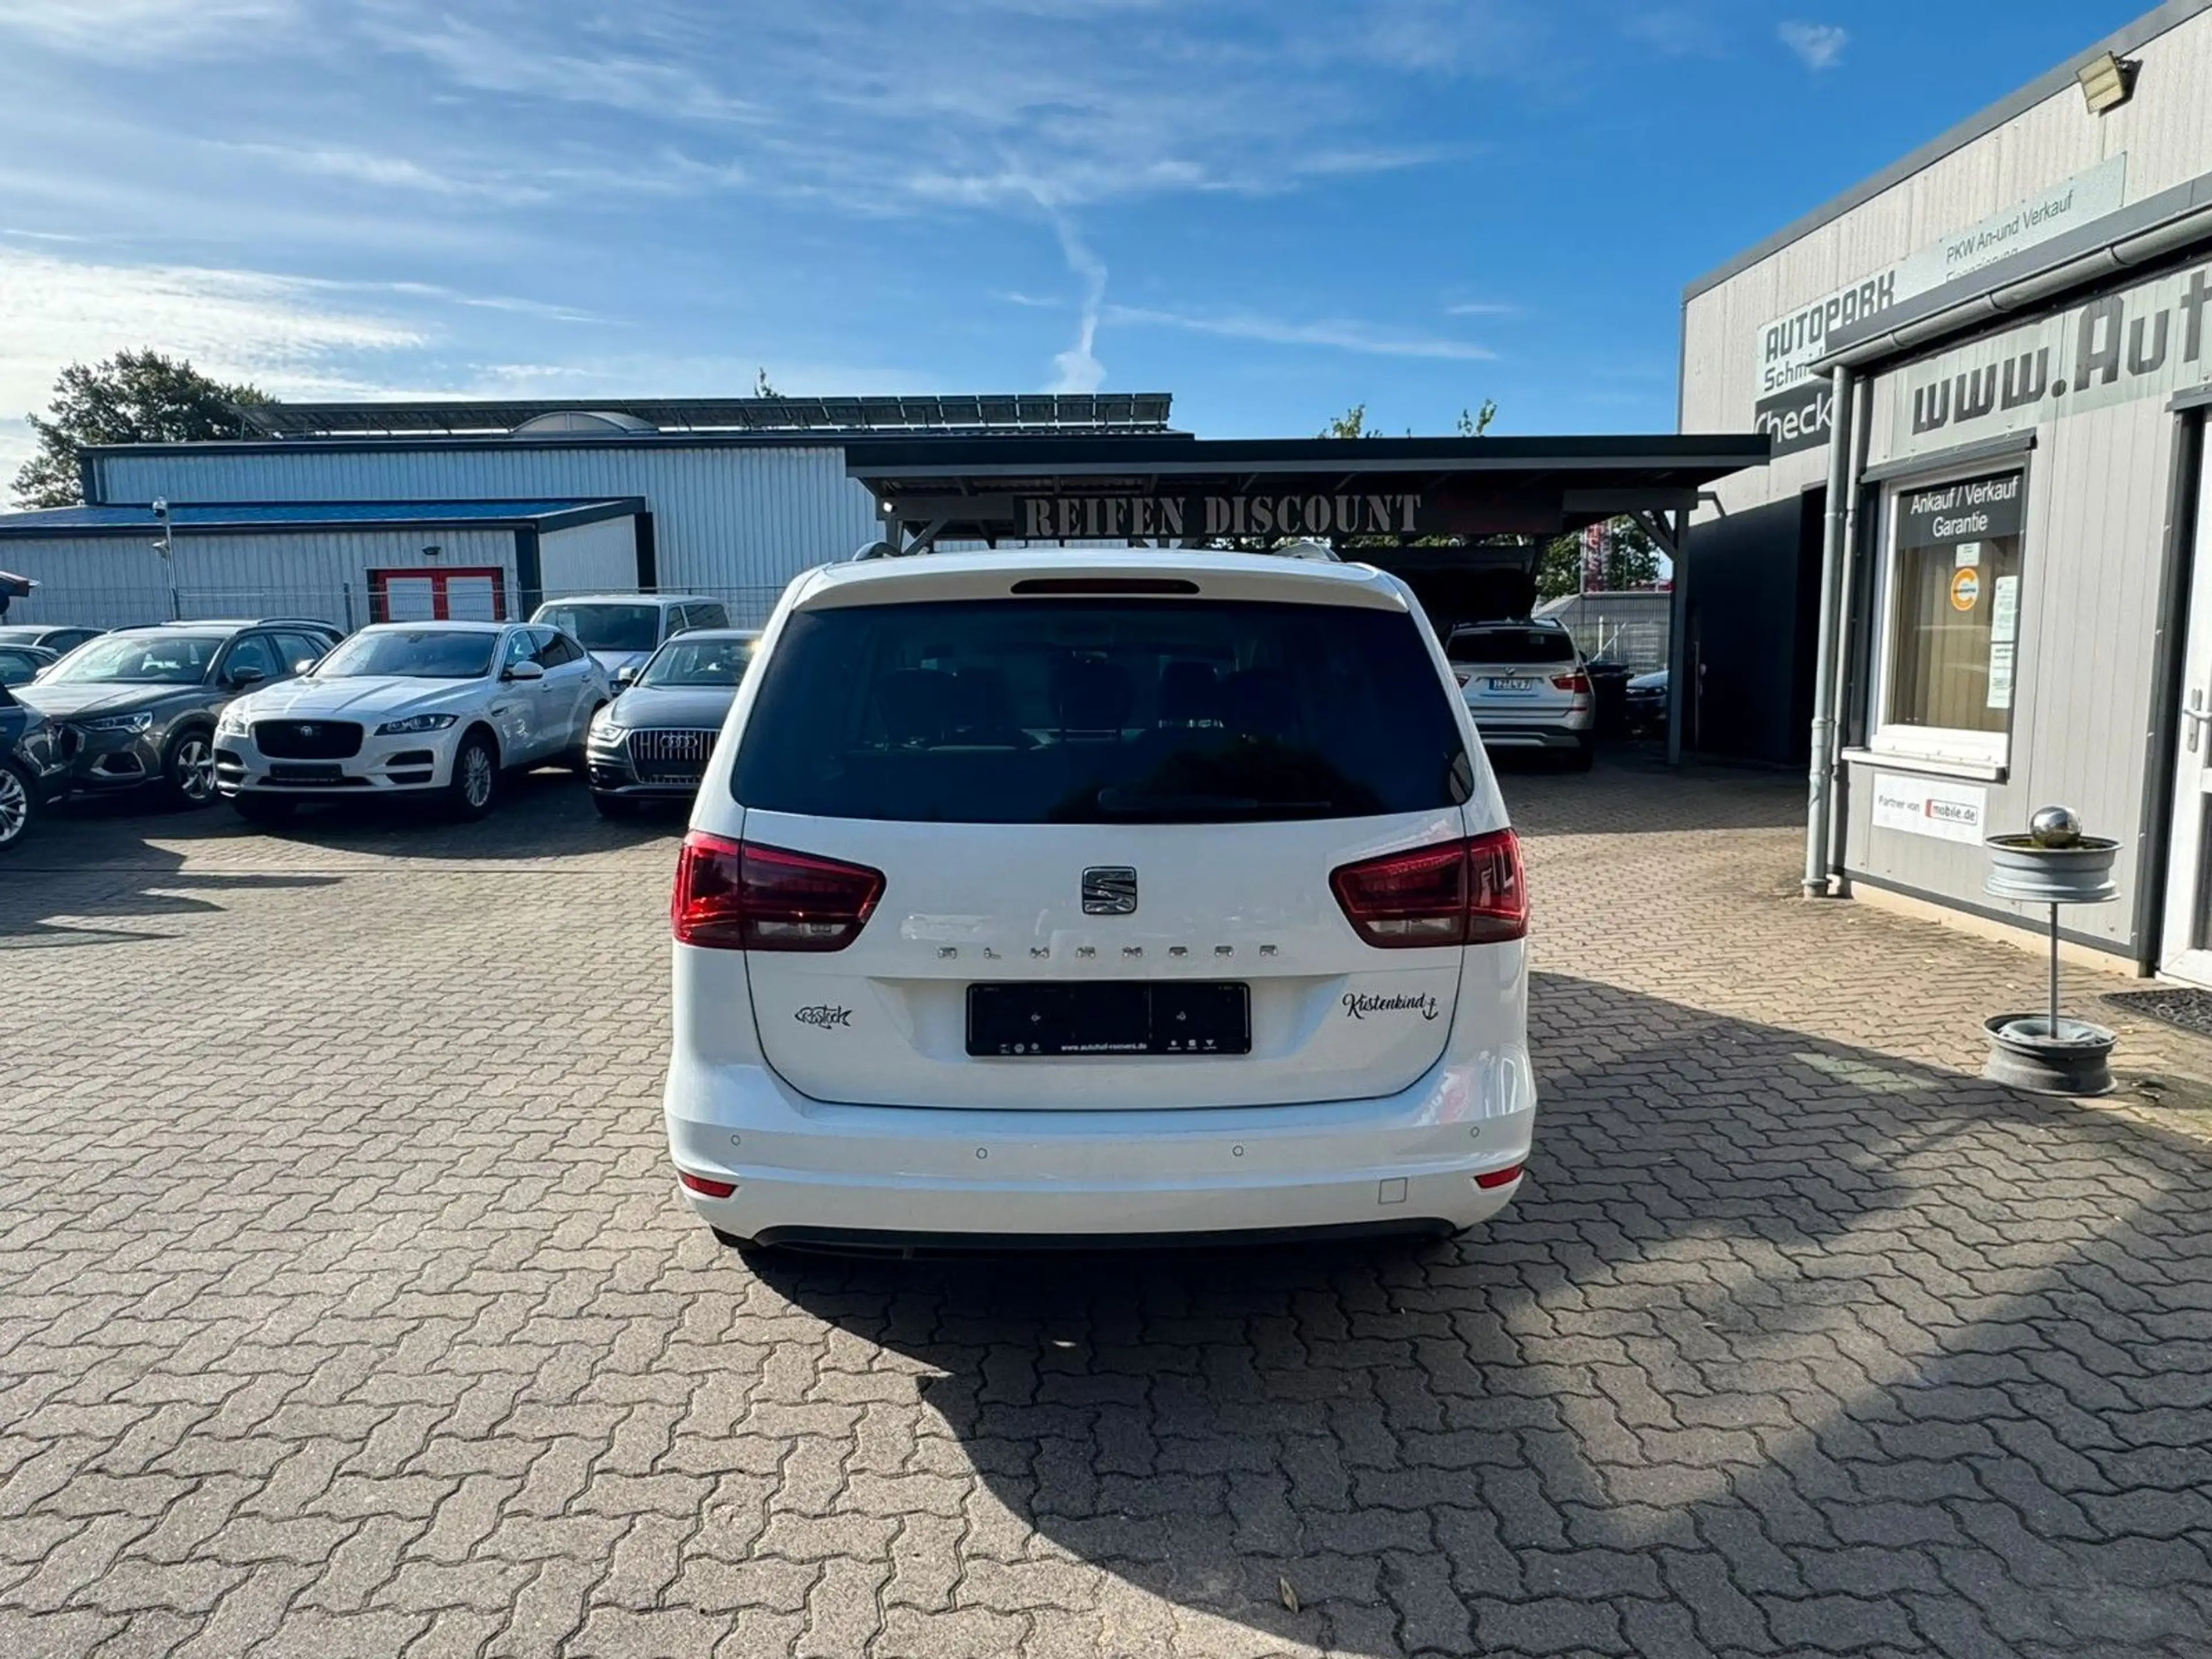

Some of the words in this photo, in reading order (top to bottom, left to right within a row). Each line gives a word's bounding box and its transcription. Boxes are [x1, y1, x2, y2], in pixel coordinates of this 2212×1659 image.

[1946, 237, 1975, 264] PKW
[2022, 189, 2074, 229] Verkauf
[1766, 270, 1895, 364] AUTOPARK
[1025, 497, 1185, 537] REIFEN
[1205, 494, 1422, 534] DISCOUNT
[1910, 488, 1956, 516] Ankauf
[1965, 475, 2021, 505] Verkauf
[1933, 511, 1988, 537] Garantie
[1878, 794, 1904, 808] Partner
[1907, 802, 1920, 812] von
